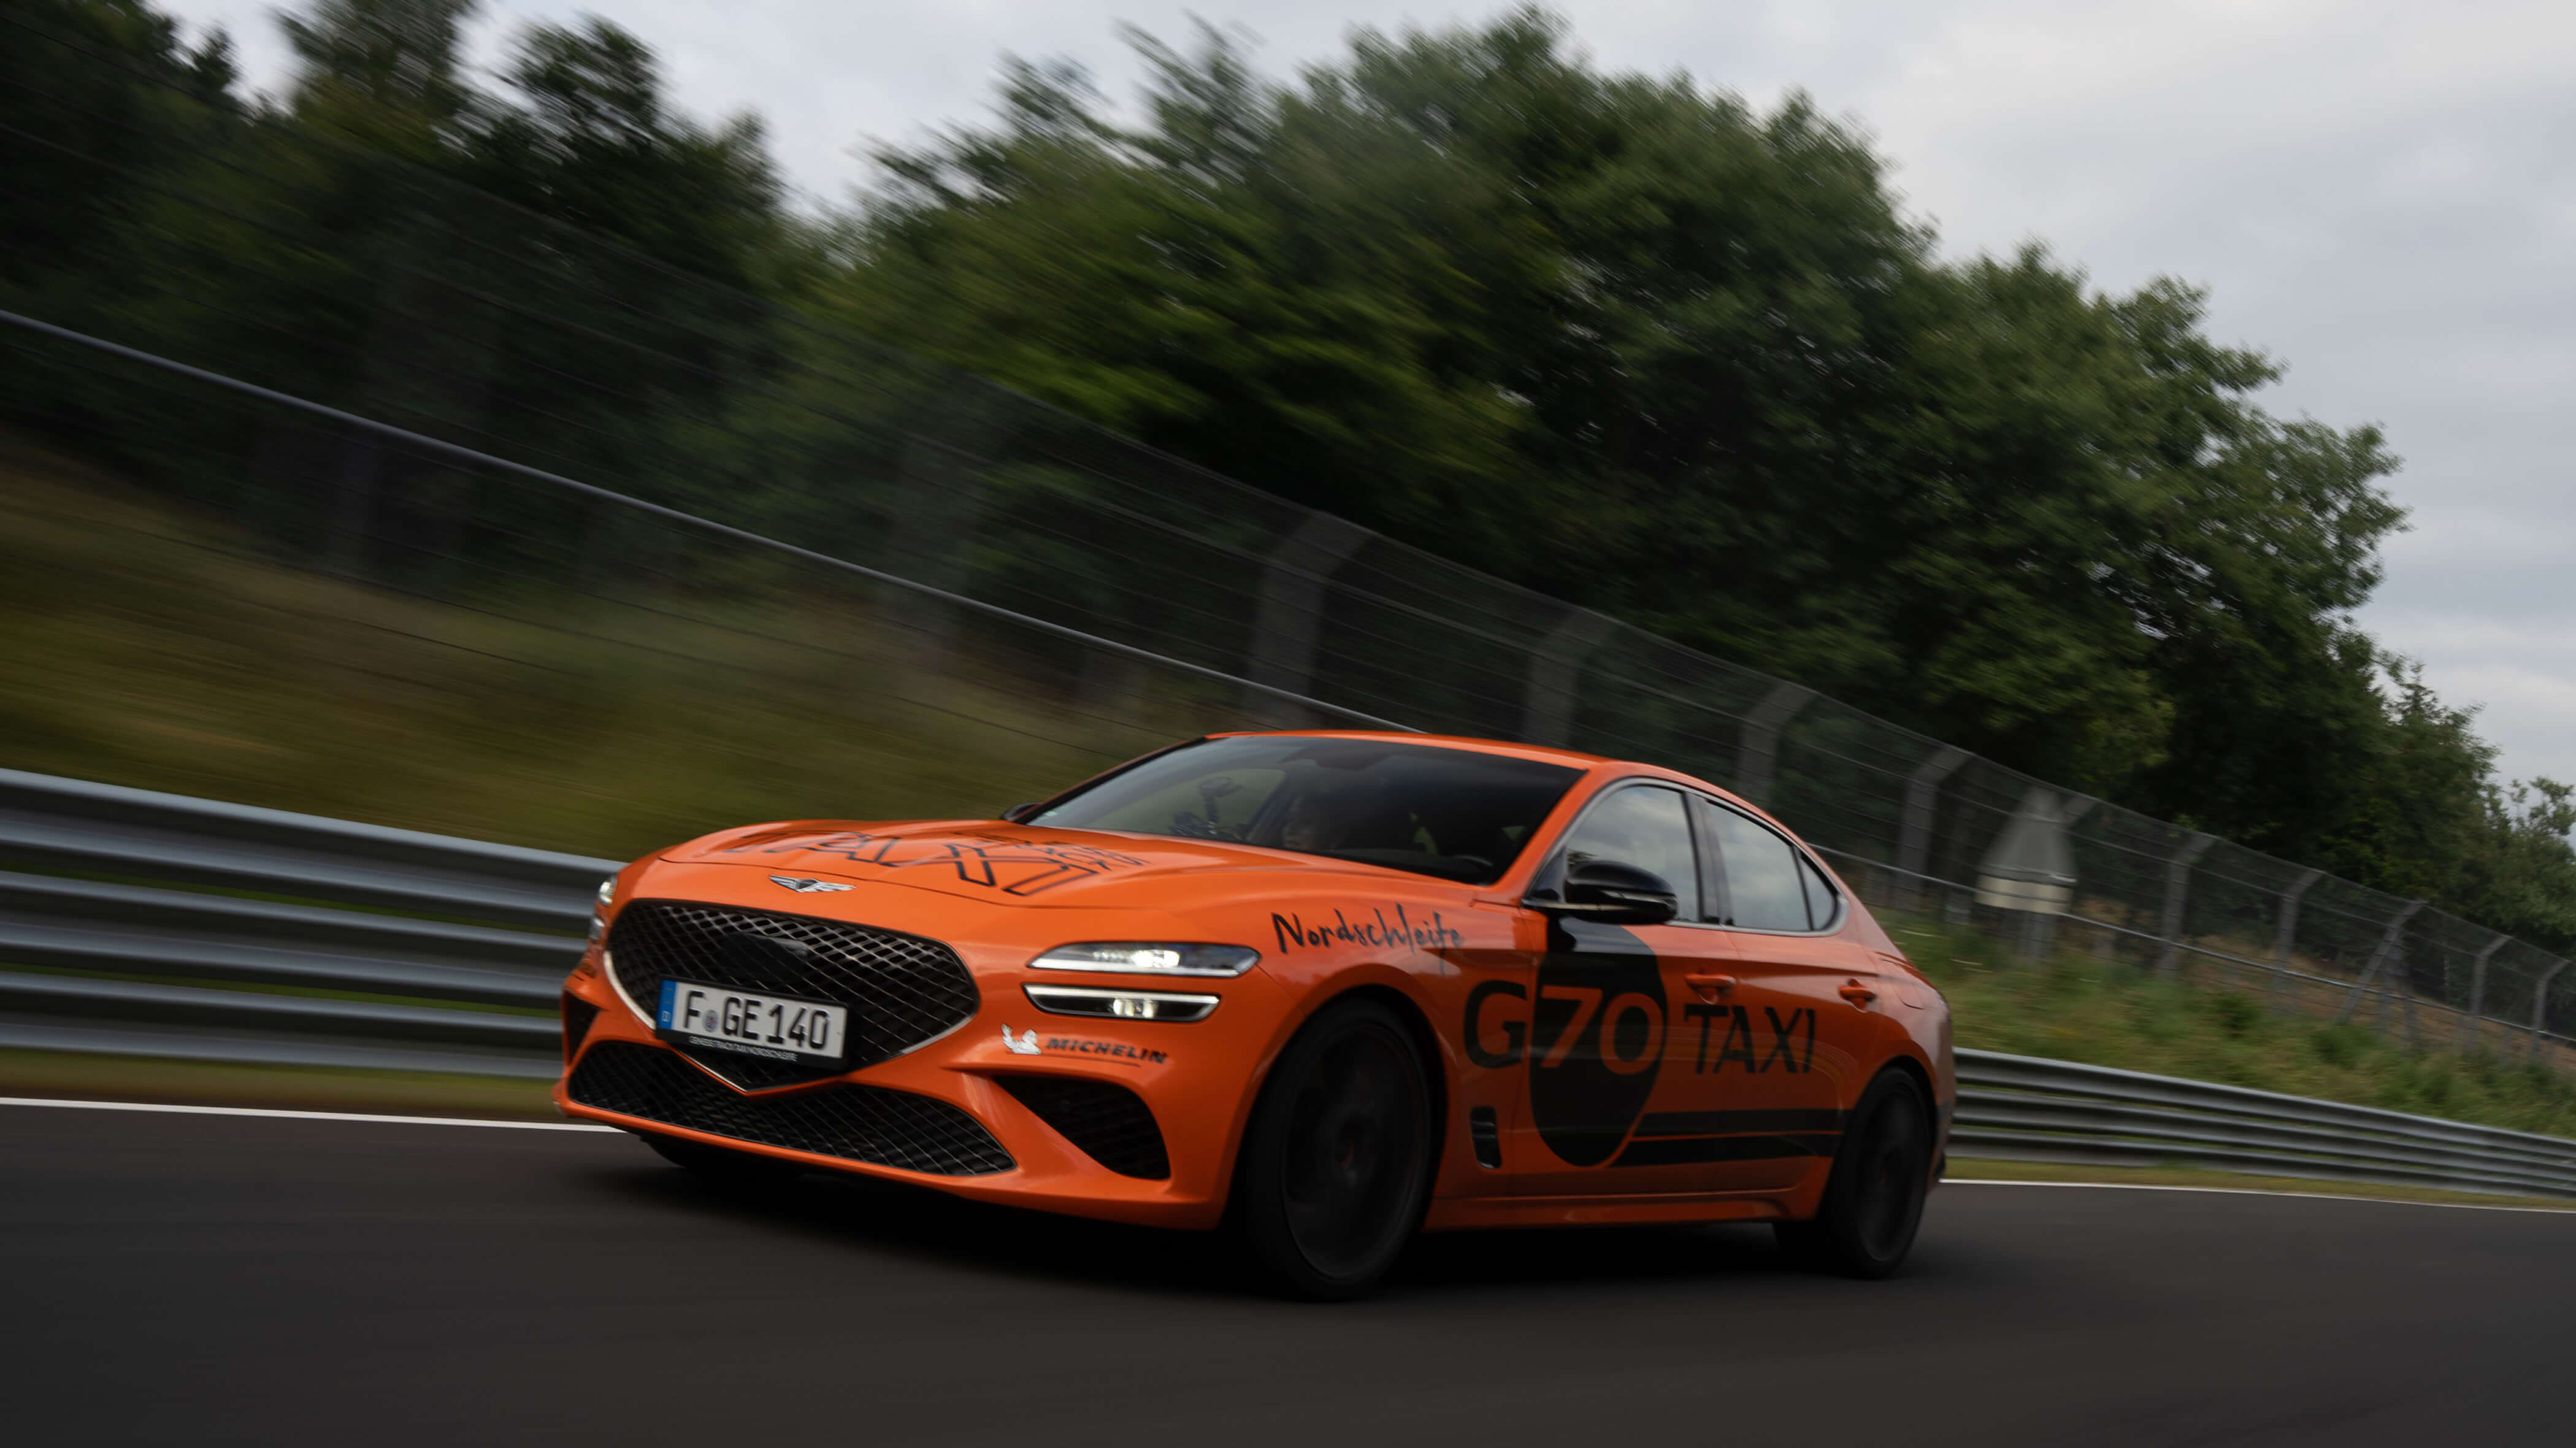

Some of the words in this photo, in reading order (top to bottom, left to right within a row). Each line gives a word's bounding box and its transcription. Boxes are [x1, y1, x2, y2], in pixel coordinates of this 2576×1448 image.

[683, 990, 705, 1029] F
[1463, 979, 1663, 1075] G70
[1684, 1003, 1815, 1075] TAXI
[1046, 1038, 1168, 1064] MICHELIN
